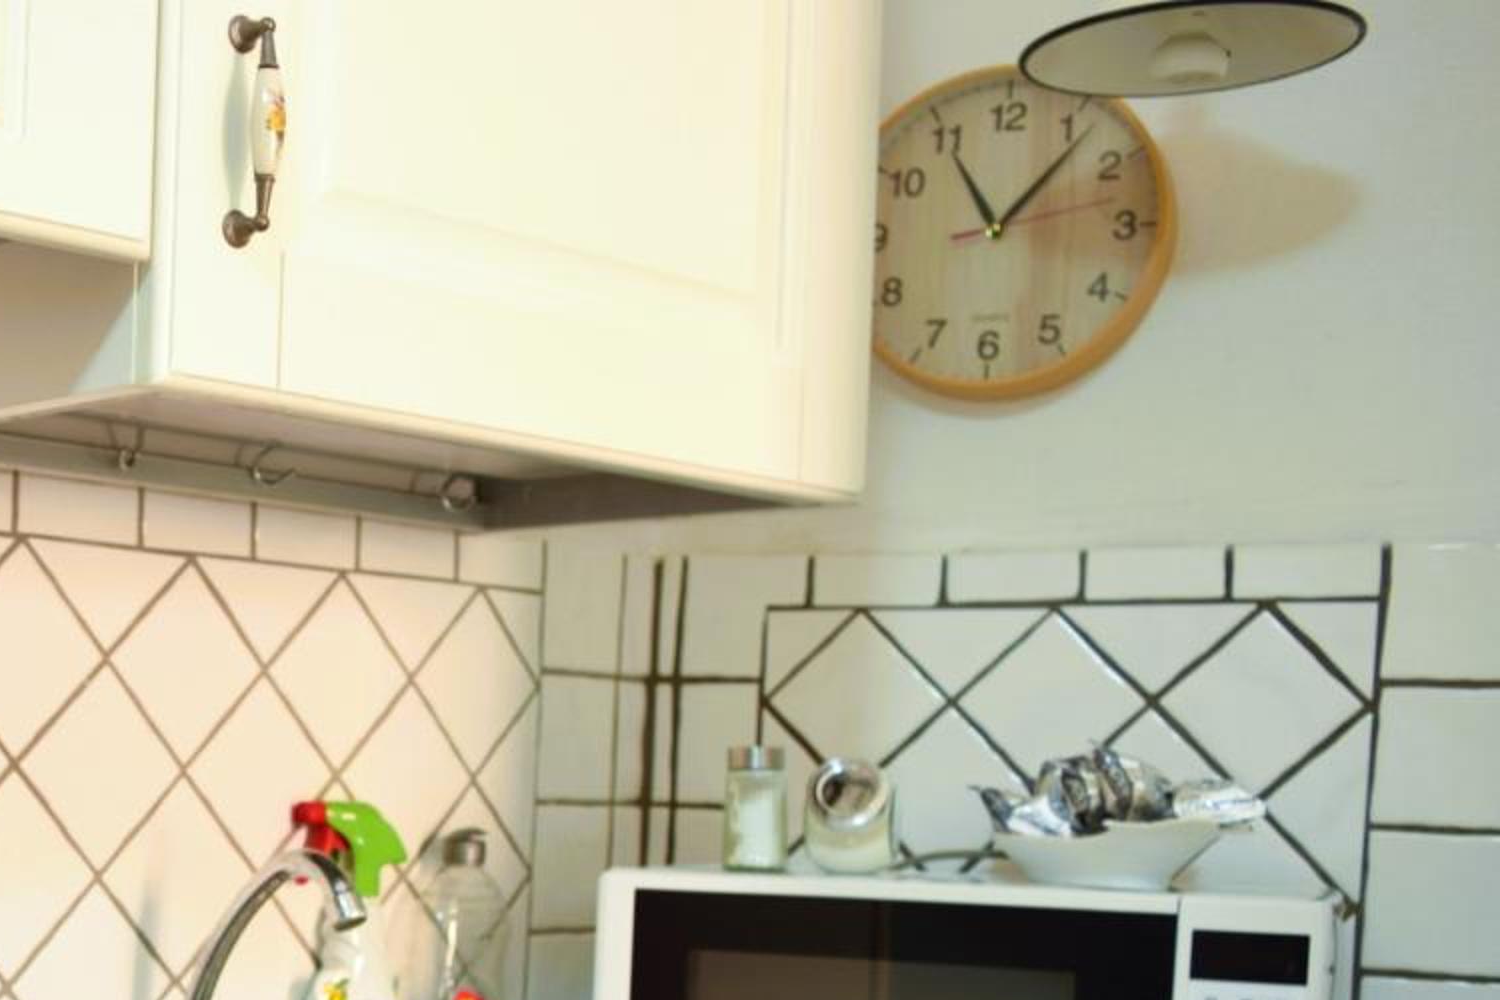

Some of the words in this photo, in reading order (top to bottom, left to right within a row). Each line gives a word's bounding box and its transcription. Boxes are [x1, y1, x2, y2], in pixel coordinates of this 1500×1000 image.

[991, 102, 1027, 132] 12
[1060, 114, 1073, 142] 1
[933, 124, 962, 154] 11
[1098, 151, 1122, 181] 2
[889, 168, 925, 198] 10
[1113, 210, 1137, 241] 3
[881, 277, 903, 307] 8
[1087, 272, 1110, 301] 4
[926, 319, 947, 348] 7
[1037, 314, 1061, 345] 5
[976, 330, 1000, 361] 6
